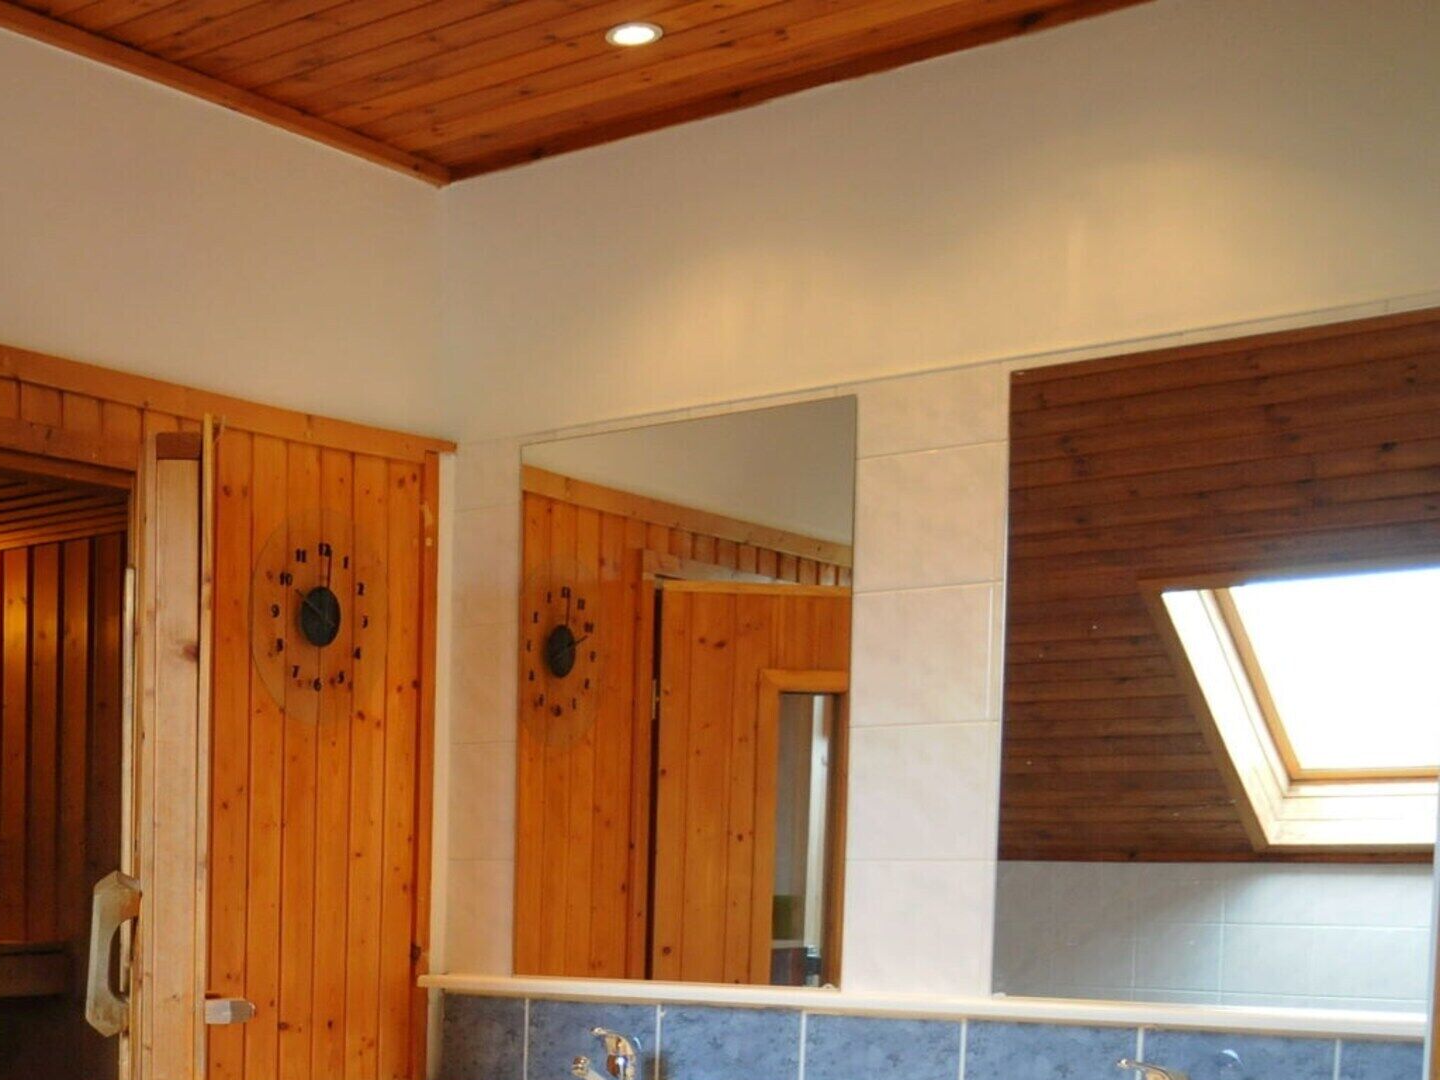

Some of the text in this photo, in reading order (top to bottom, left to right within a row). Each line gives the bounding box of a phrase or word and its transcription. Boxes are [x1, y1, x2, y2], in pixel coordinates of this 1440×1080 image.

[295, 548, 307, 563] 11
[343, 555, 349, 569] 1
[279, 571, 293, 586] 10
[357, 582, 365, 596] 2
[271, 604, 280, 618] 9
[361, 615, 369, 628] 3
[276, 638, 284, 652] 8
[353, 646, 361, 660] 4
[292, 665, 299, 678] 7
[337, 671, 345, 684] 5
[313, 677, 322, 692] 6
